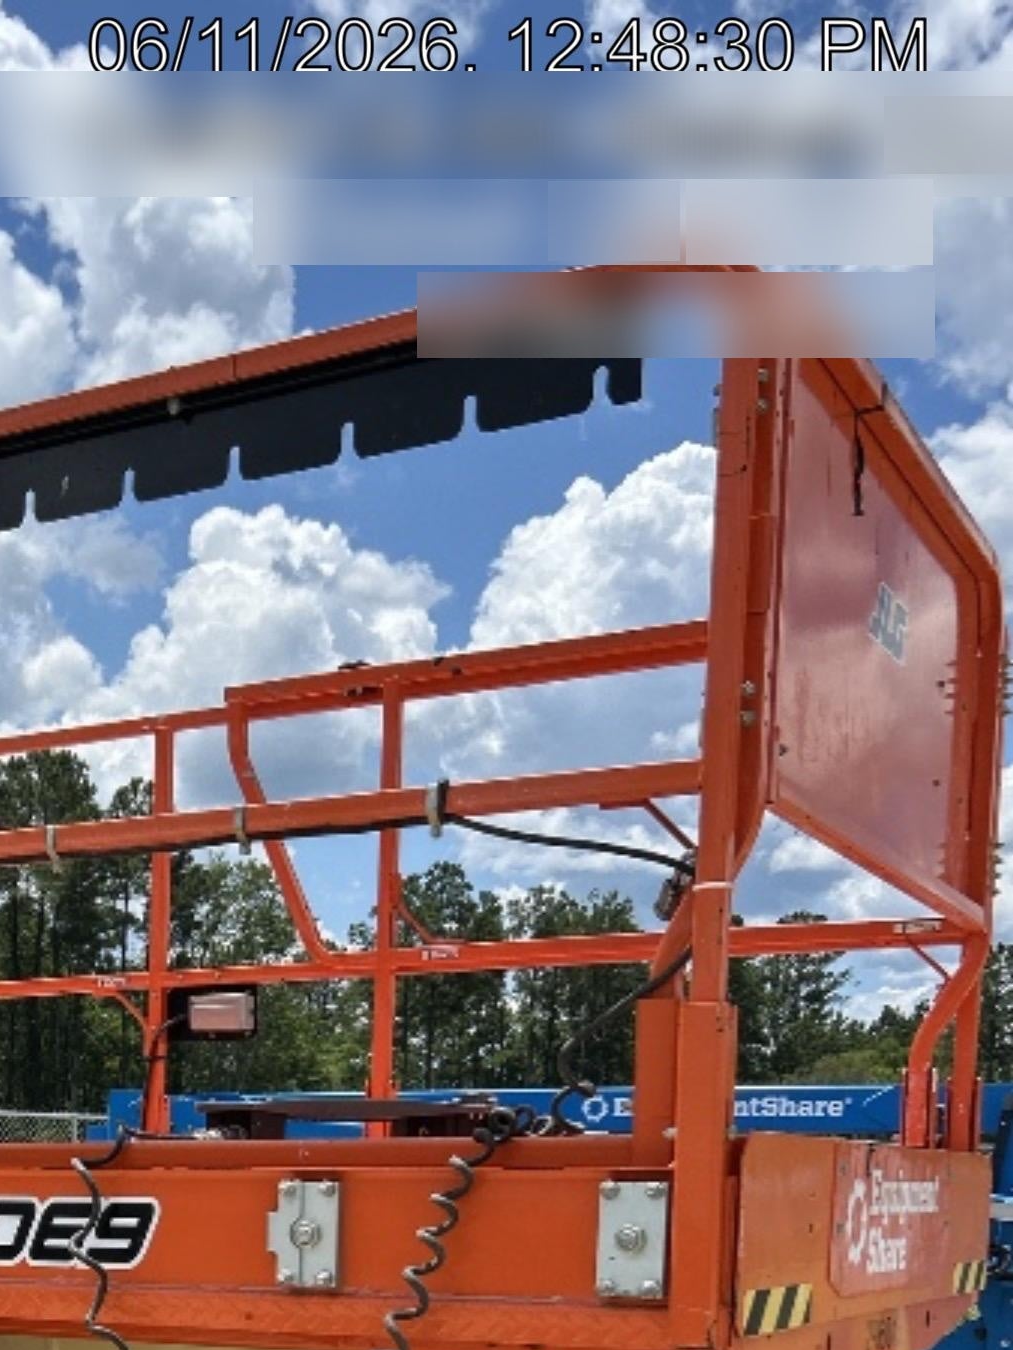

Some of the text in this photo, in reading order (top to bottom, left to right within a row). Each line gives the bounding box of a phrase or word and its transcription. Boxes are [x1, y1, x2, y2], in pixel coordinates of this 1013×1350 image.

[613, 1097, 844, 1117] EntShare
[868, 1169, 939, 1224] Equipment
[866, 1227, 906, 1275] Share
